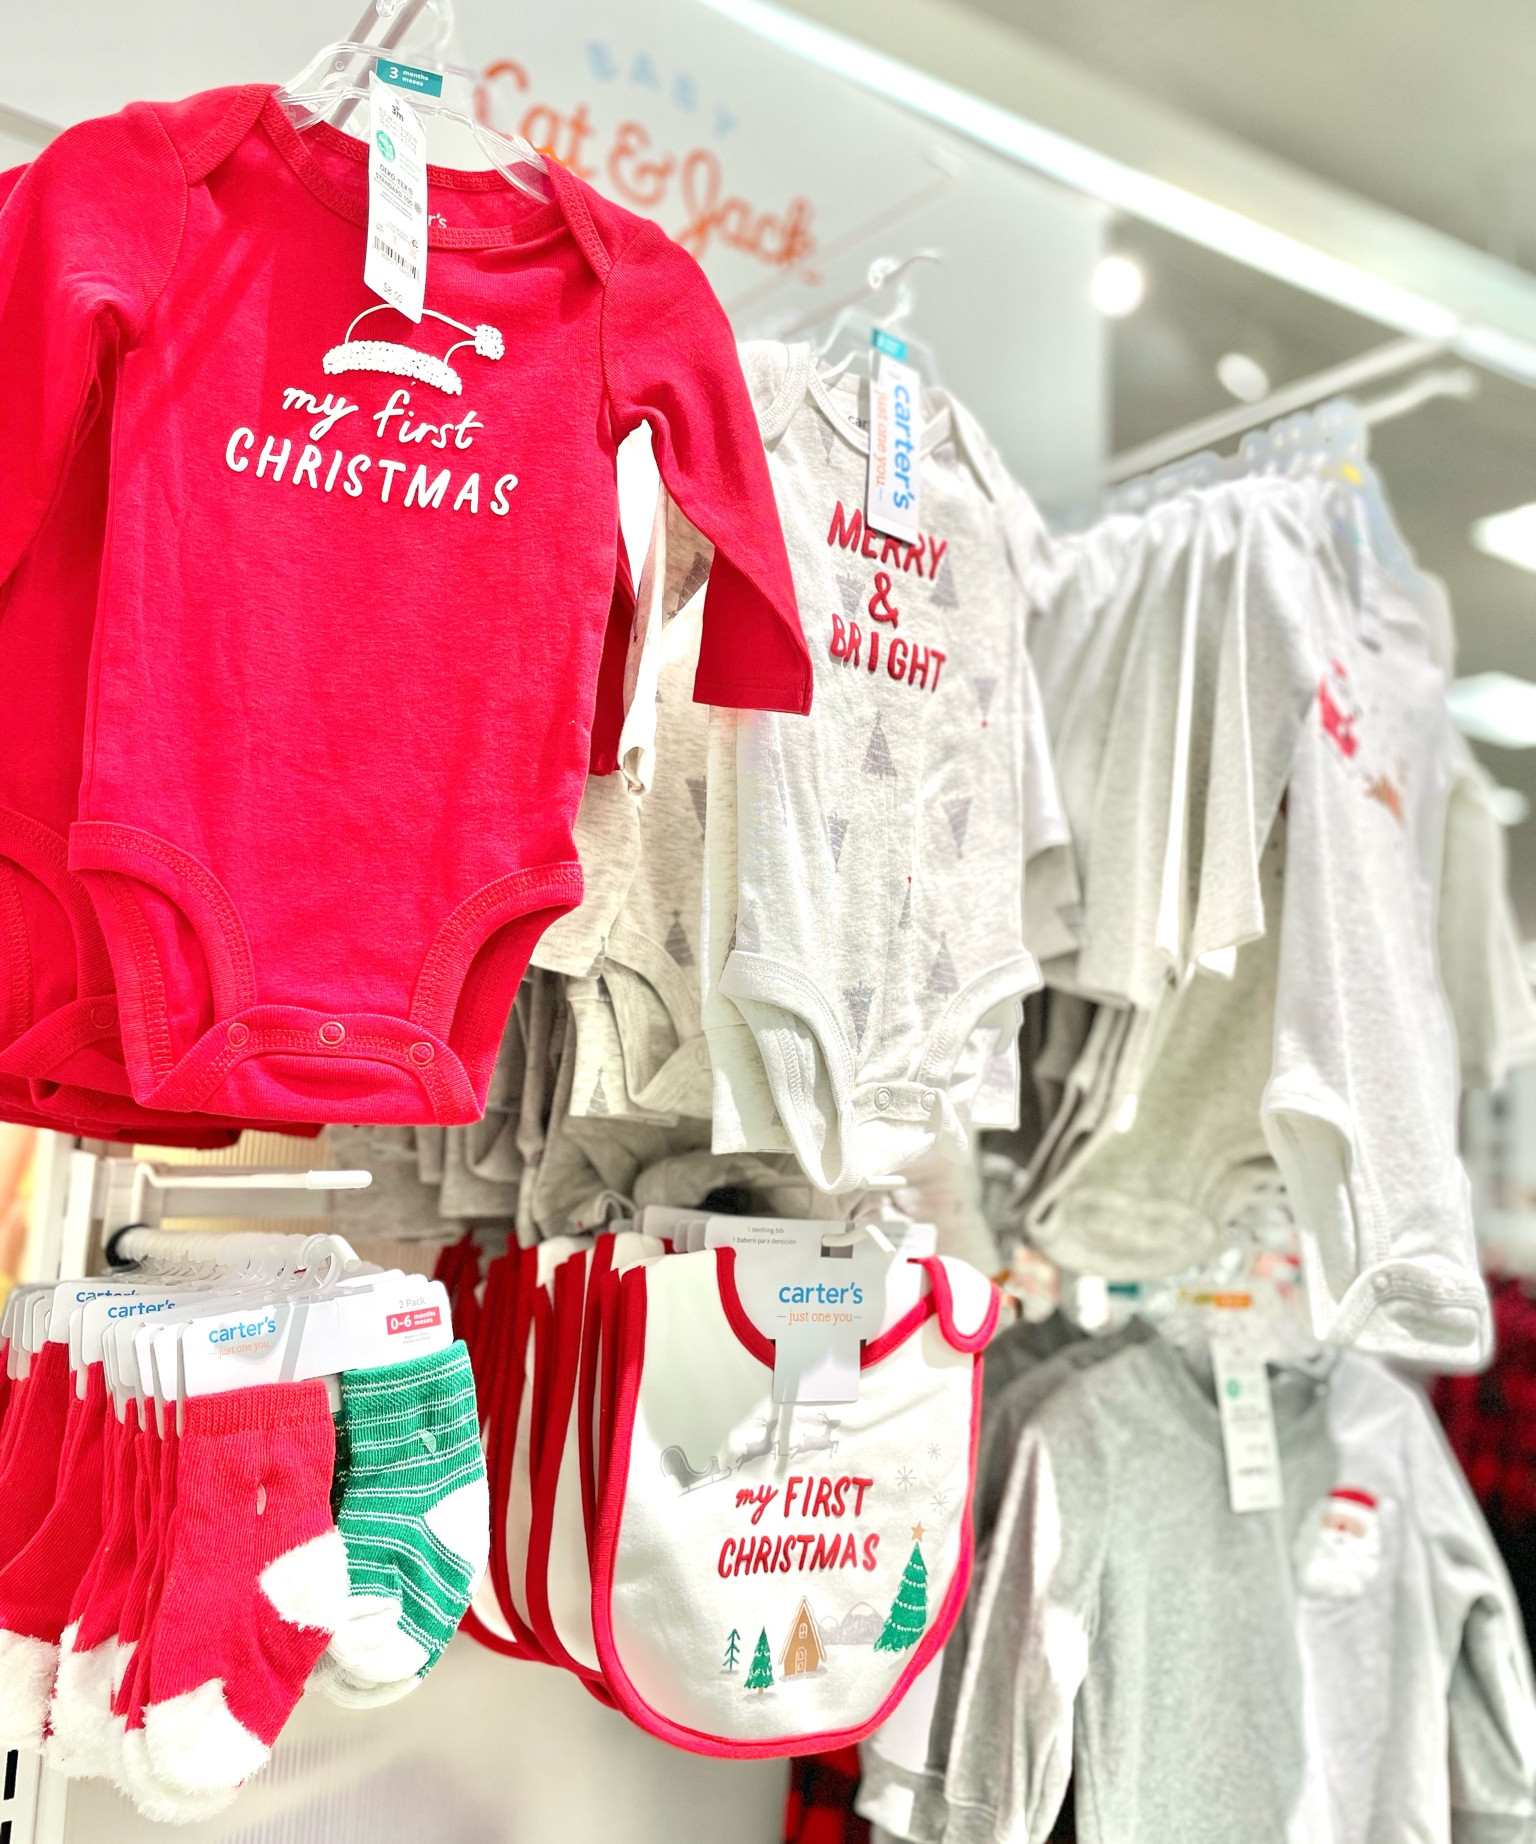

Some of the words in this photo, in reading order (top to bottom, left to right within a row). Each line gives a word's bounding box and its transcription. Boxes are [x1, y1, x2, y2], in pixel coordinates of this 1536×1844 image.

[388, 66, 399, 80] 3
[402, 70, 429, 81] months
[402, 77, 424, 87] meses
[607, 120, 676, 207] &
[672, 147, 816, 265] Jack
[282, 387, 359, 441] my
[372, 389, 484, 449] first
[893, 384, 916, 510] carter's
[225, 427, 518, 516] CHRISTMAS
[868, 571, 899, 629] &
[829, 612, 947, 693] BRIGHT
[399, 1299, 405, 1309] 2
[405, 1296, 426, 1308] Pack
[778, 1281, 864, 1305] carter's
[390, 1314, 413, 1331] 0-6
[413, 1310, 436, 1320] months
[414, 1317, 434, 1326] meses
[787, 1309, 810, 1327] just
[811, 1311, 831, 1323] one
[831, 1311, 853, 1327] you
[208, 1316, 277, 1343] carter's
[218, 1345, 236, 1360] just
[236, 1342, 253, 1353] one
[735, 1485, 779, 1525] my
[783, 1475, 874, 1518] FIRST
[717, 1532, 880, 1579] CHRISTMAS
